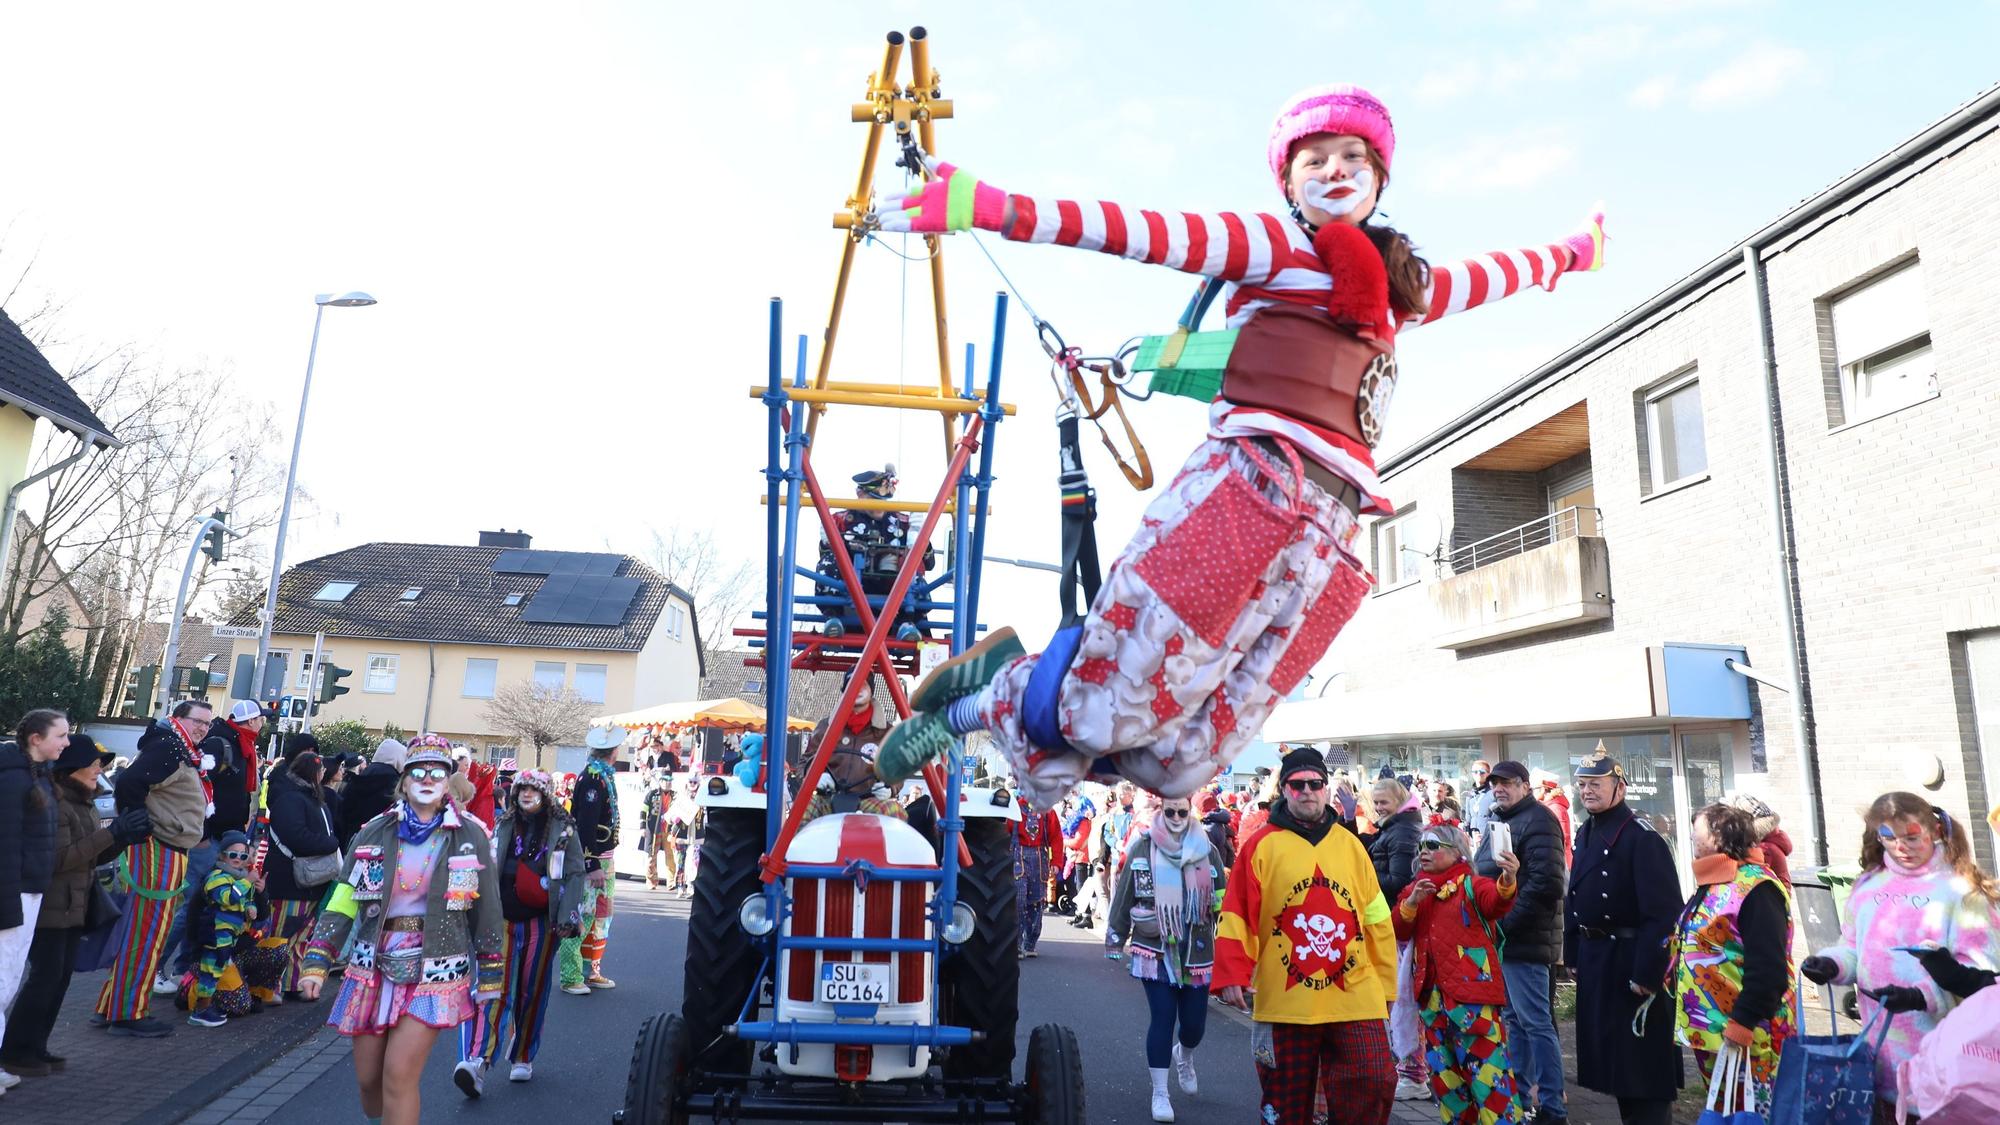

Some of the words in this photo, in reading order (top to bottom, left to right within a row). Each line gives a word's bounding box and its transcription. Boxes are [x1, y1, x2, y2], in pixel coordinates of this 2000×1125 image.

[216, 627, 235, 636] Linzer
[236, 628, 257, 637] Straße
[834, 965, 856, 982] SU
[826, 984, 848, 1000] CC
[852, 984, 883, 1001] 164
